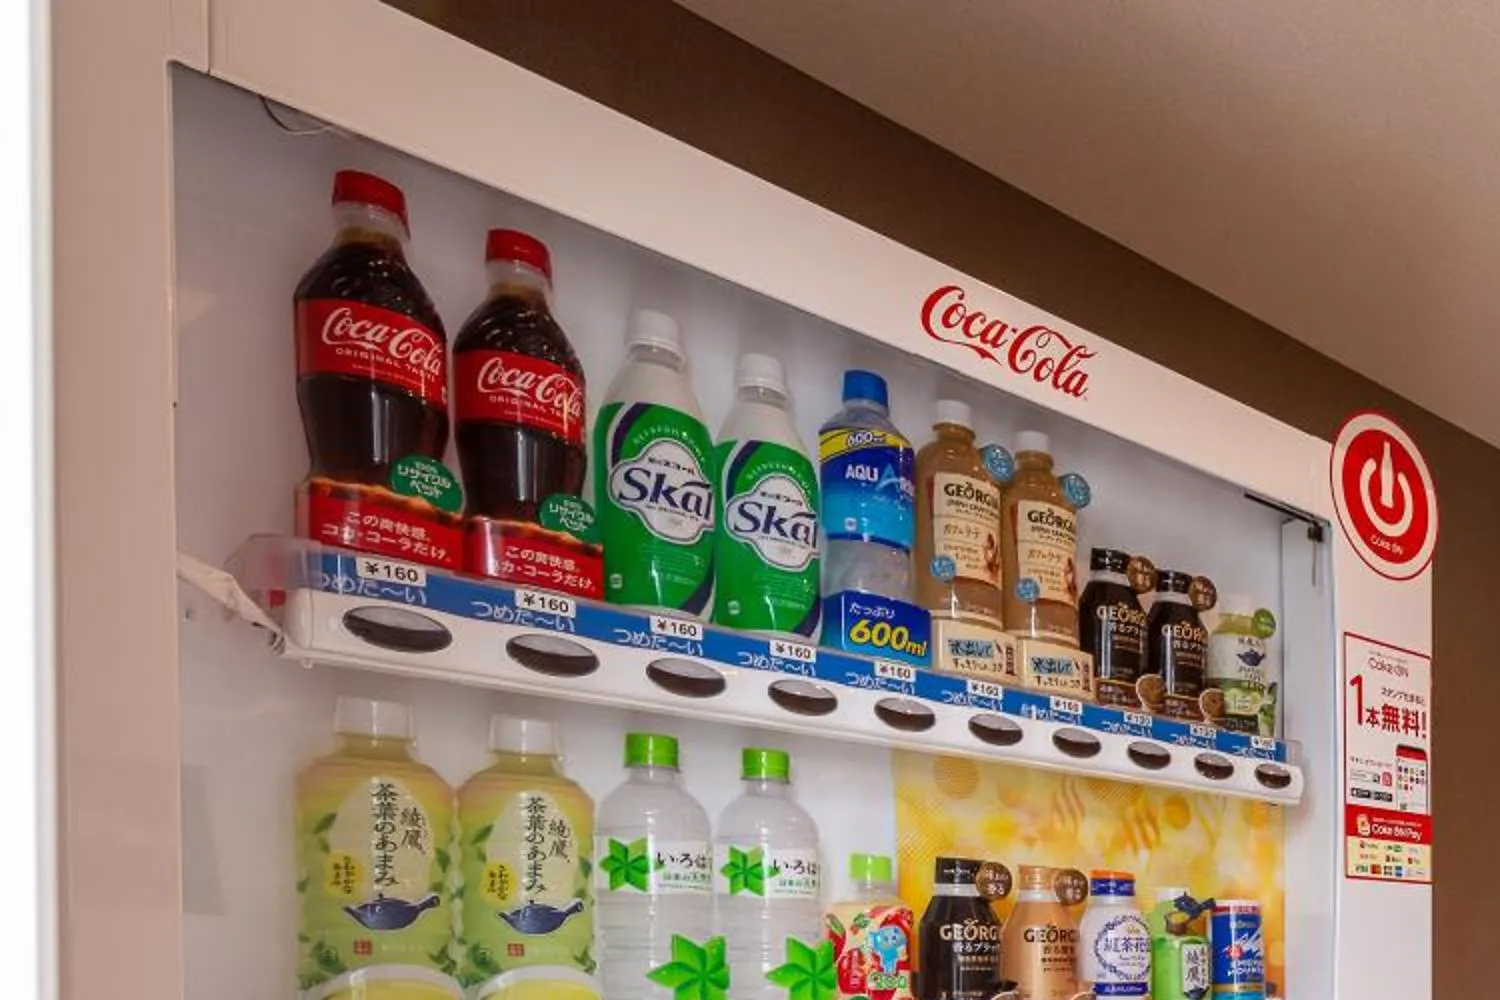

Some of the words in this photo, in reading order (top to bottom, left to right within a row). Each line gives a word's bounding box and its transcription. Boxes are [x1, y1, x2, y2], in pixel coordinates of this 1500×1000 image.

[322, 307, 442, 376] Coca-Cola
[920, 285, 1098, 398] Coca-Cola
[477, 357, 582, 417] Coca-Cola
[363, 562, 419, 584] ¥160
[522, 591, 570, 614] ¥160
[656, 619, 698, 636] ¥160
[775, 643, 812, 659] ¥160
[850, 619, 928, 657] 600ml
[371, 783, 399, 887] 茶葉のあまみ
[524, 796, 547, 892] 茶葉のあまみ
